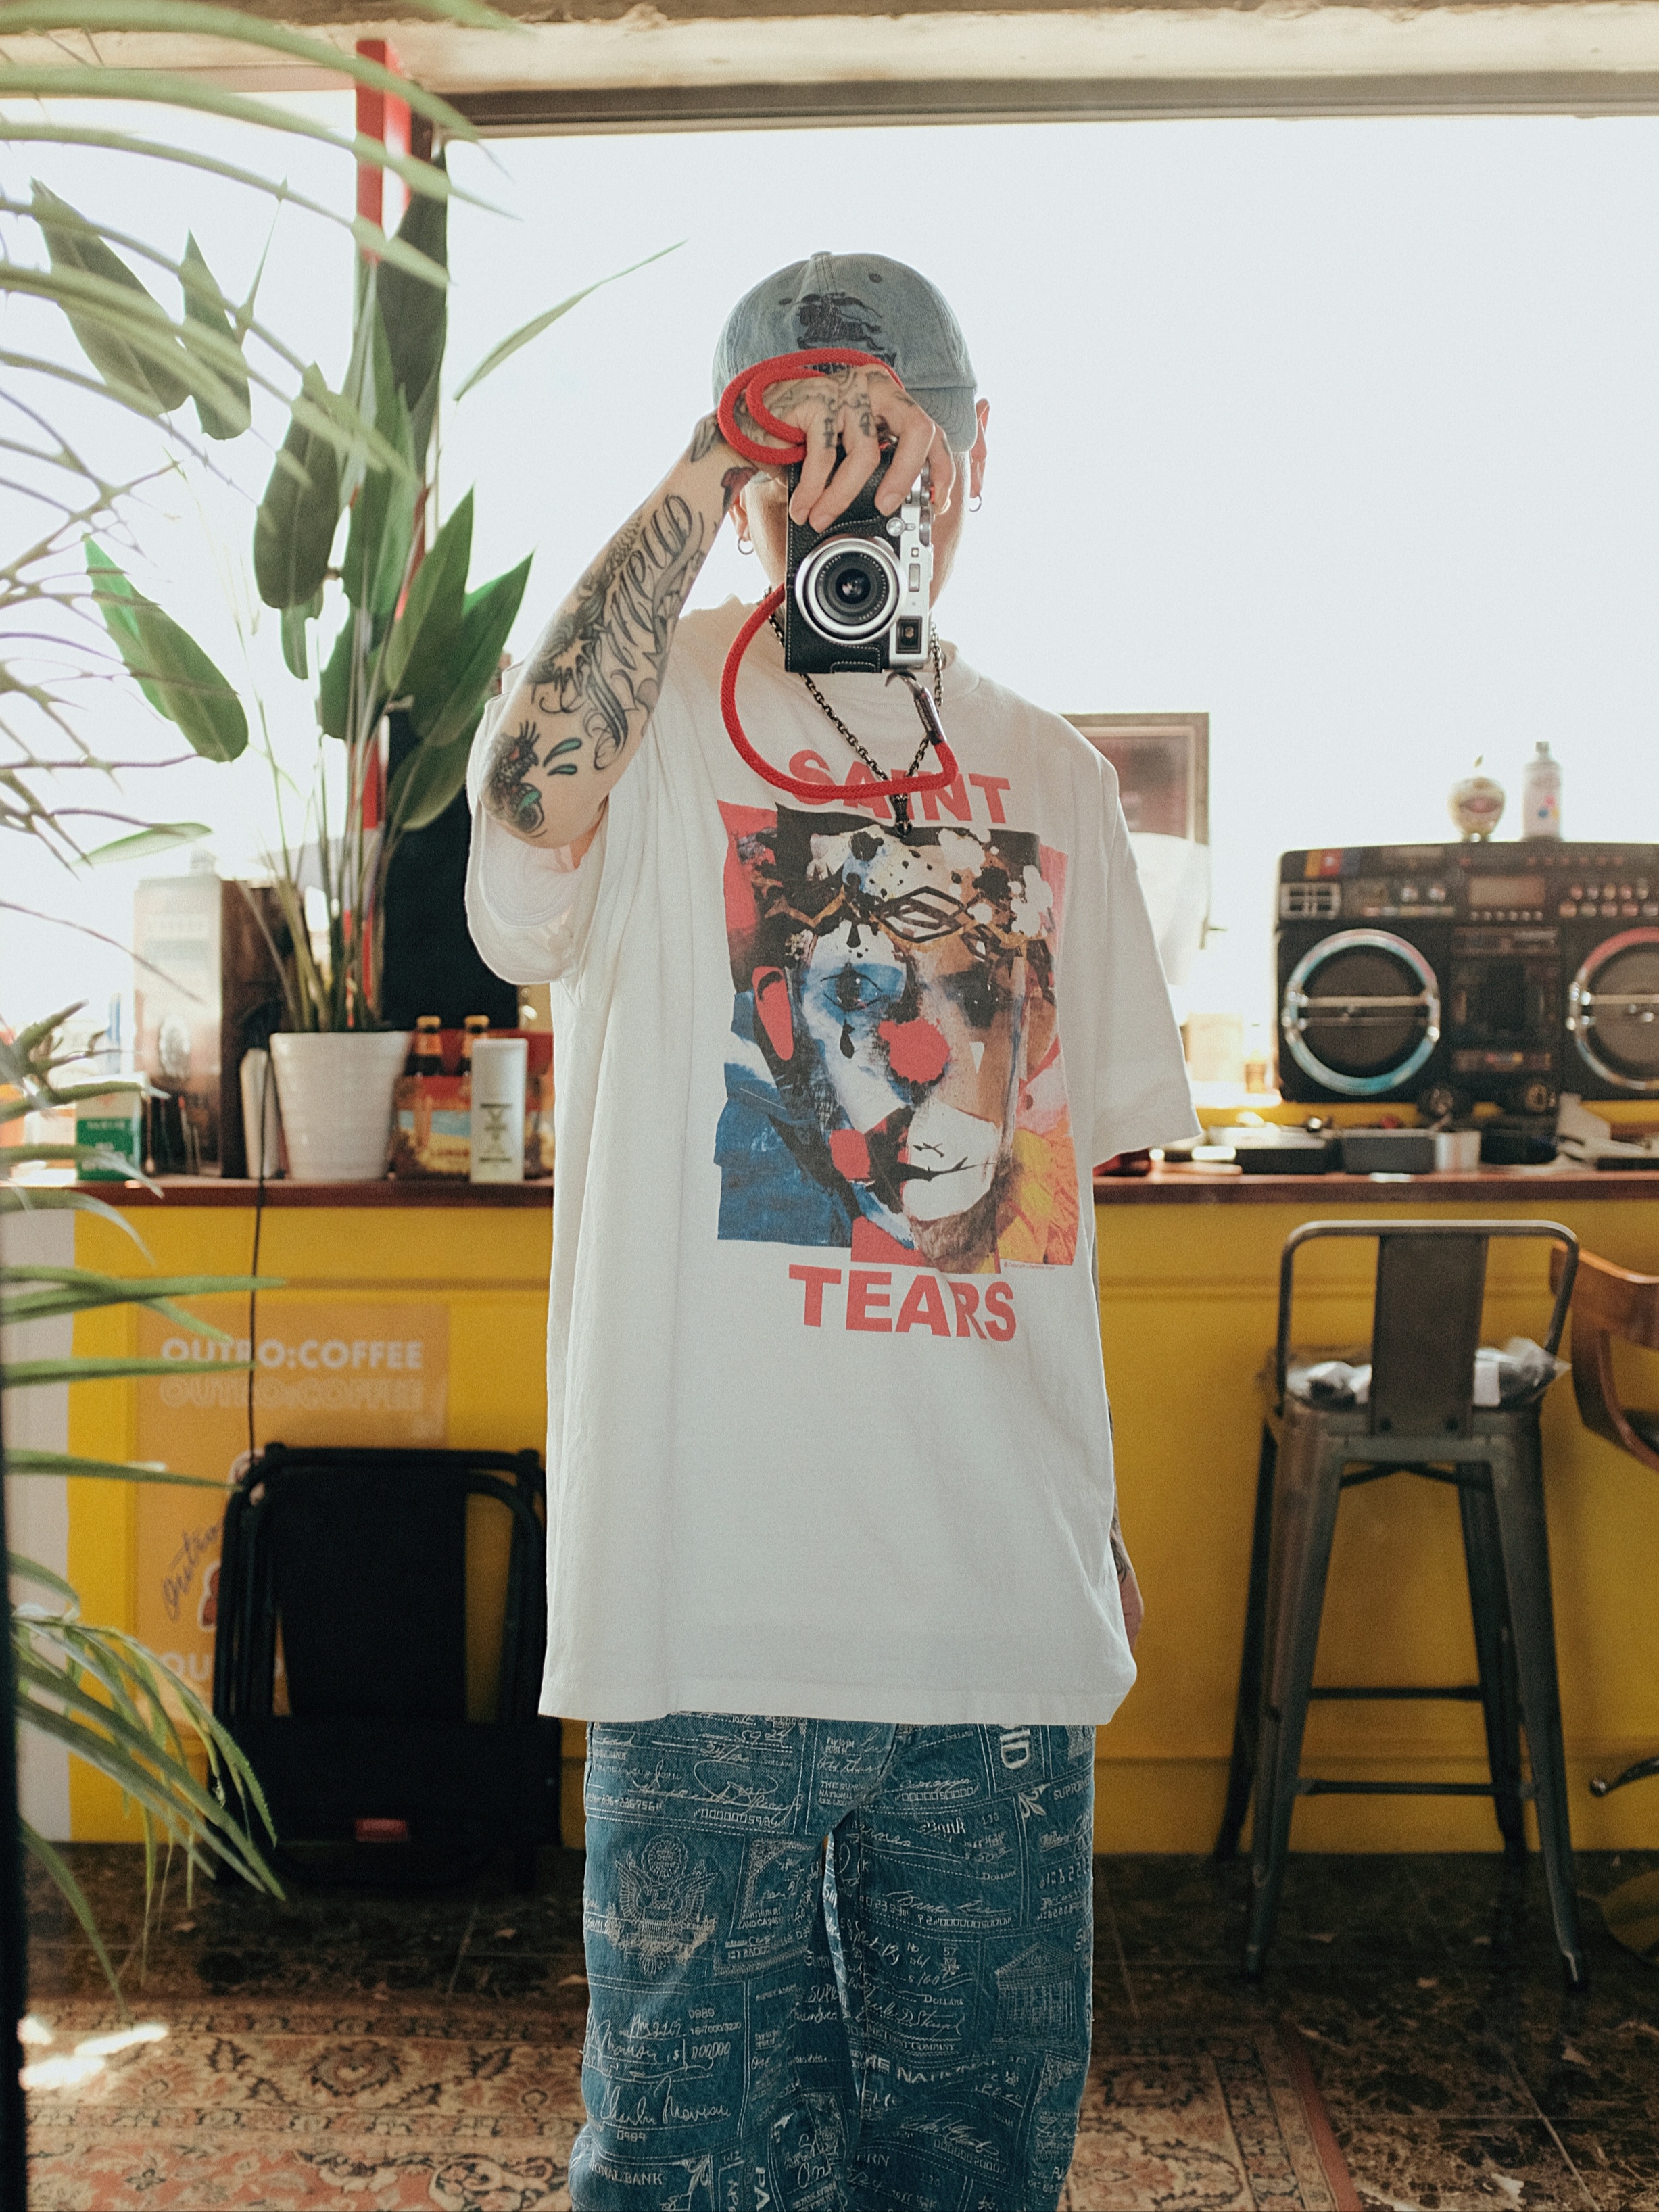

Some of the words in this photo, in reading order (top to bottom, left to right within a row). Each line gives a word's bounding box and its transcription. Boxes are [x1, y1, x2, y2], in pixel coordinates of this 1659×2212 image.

[788, 1264, 1017, 1342] TEARS
[911, 2041, 955, 2051] COMPANY
[623, 2172, 663, 2186] BANK
